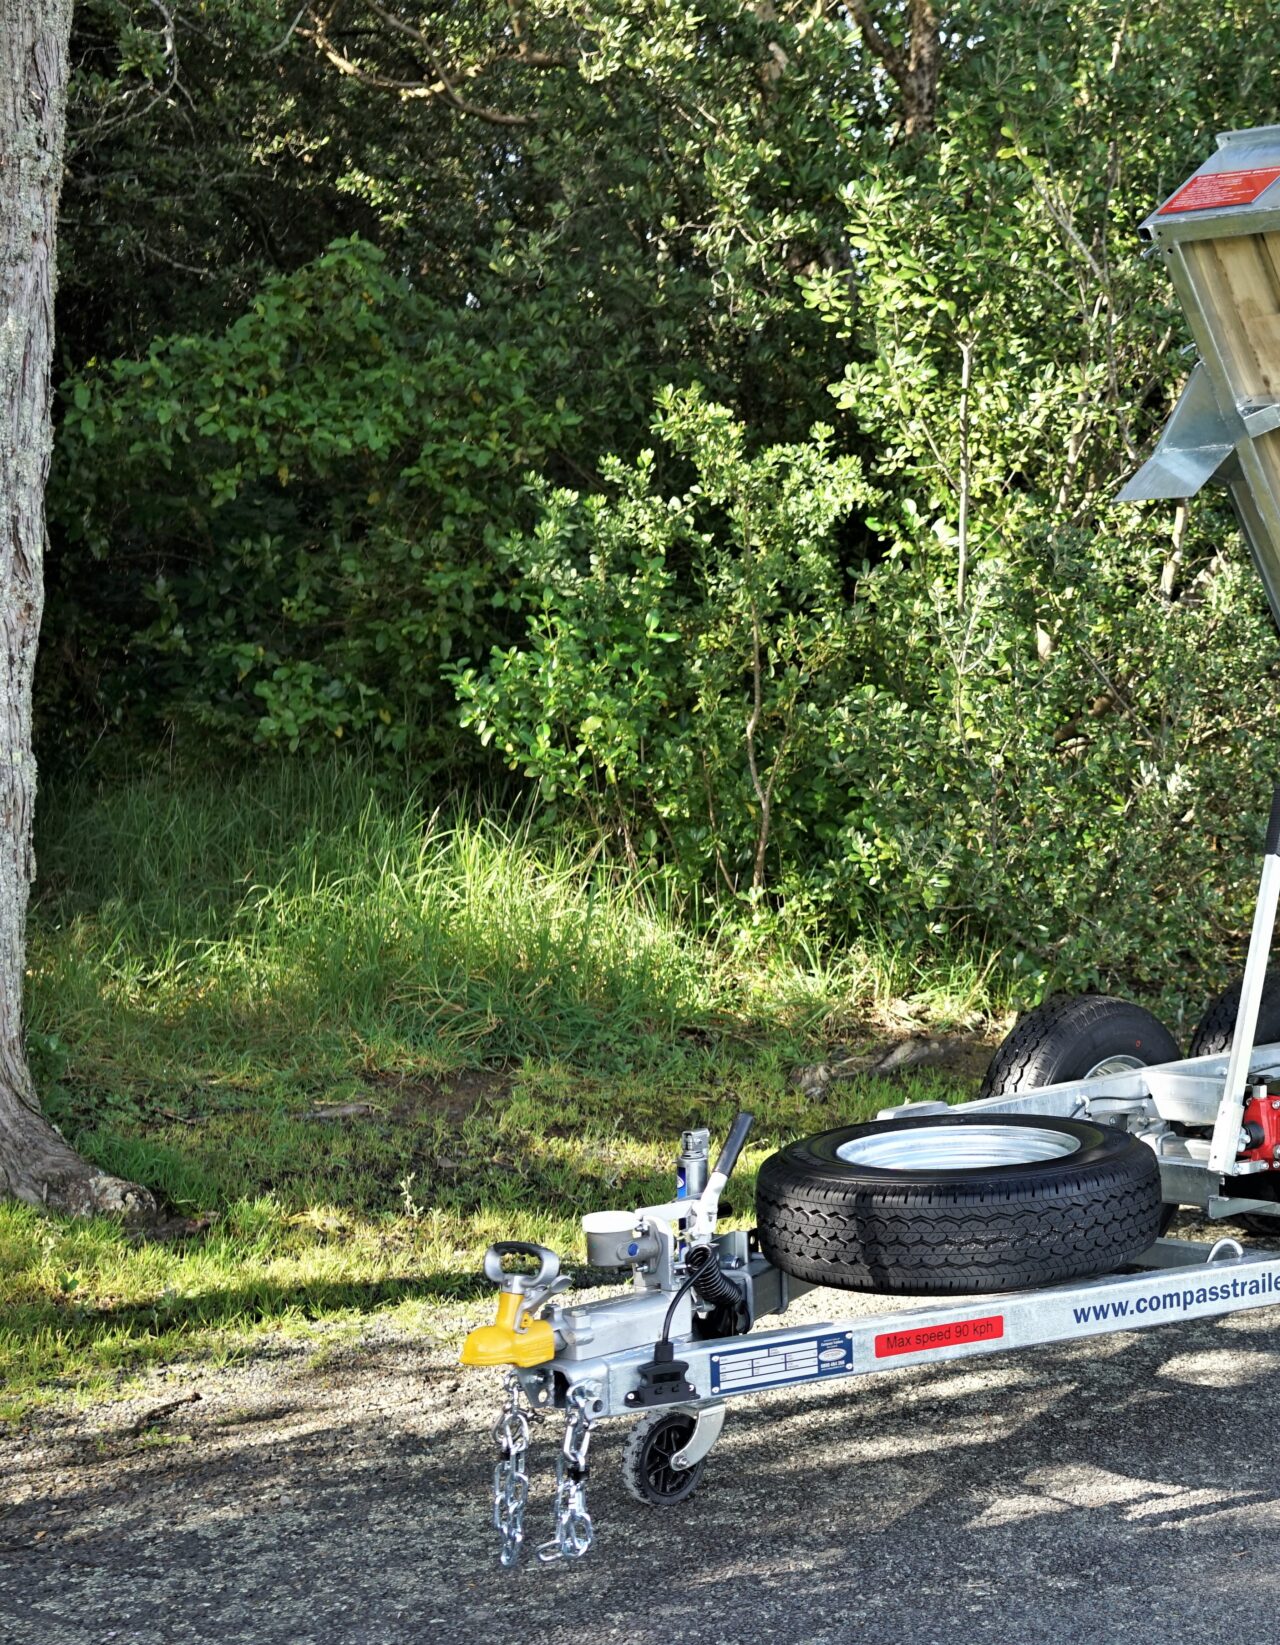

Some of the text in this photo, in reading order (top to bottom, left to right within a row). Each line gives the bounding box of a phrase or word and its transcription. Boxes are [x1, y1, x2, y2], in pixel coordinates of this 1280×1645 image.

[886, 1321, 993, 1349] Max speed 90 kph
